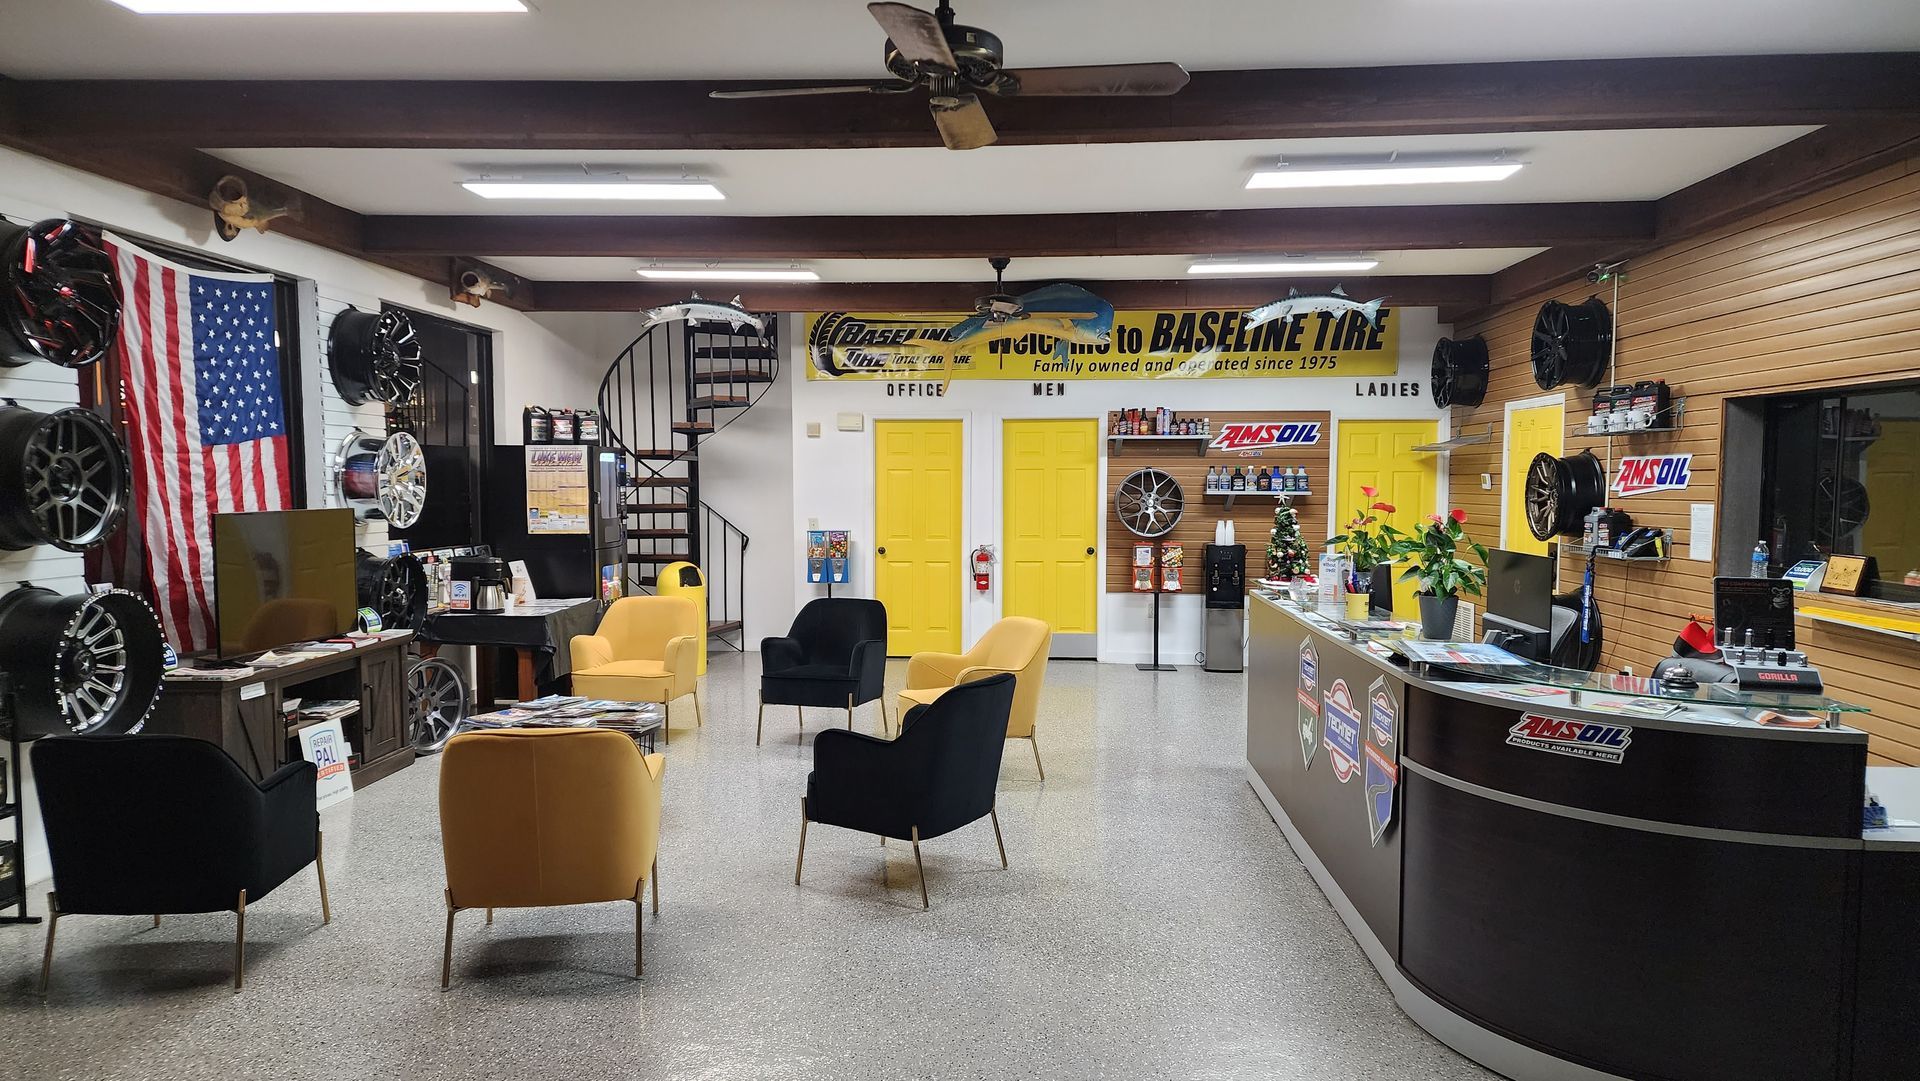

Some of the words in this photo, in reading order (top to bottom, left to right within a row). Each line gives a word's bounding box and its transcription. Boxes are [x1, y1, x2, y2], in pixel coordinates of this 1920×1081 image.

[988, 333, 1110, 354] elce
[1117, 325, 1142, 354] to
[1149, 311, 1308, 352] BASELINE
[1313, 309, 1390, 351] TIRE
[952, 355, 971, 364] ARE
[1034, 359, 1083, 375] Family
[1088, 358, 1139, 372] owned
[1145, 358, 1173, 371] and
[1179, 357, 1249, 375] operated
[1255, 356, 1293, 370] since
[1300, 355, 1336, 370] 1975
[887, 383, 942, 396] OFFICE
[1033, 383, 1065, 396] MEN
[1355, 383, 1420, 396] LADIES
[1216, 424, 1320, 448] AMSOIL
[1616, 458, 1688, 491] AMSOIL
[1758, 672, 1798, 682] GORILLA
[1517, 715, 1628, 746] AMSOIL
[313, 735, 333, 747] REPAIR
[1512, 737, 1550, 749] PRODUCTS
[1551, 744, 1594, 757] AVAILABLE
[1595, 752, 1618, 761] HERE
[315, 745, 336, 768] PAL
[318, 764, 344, 777] ERTIFIED
